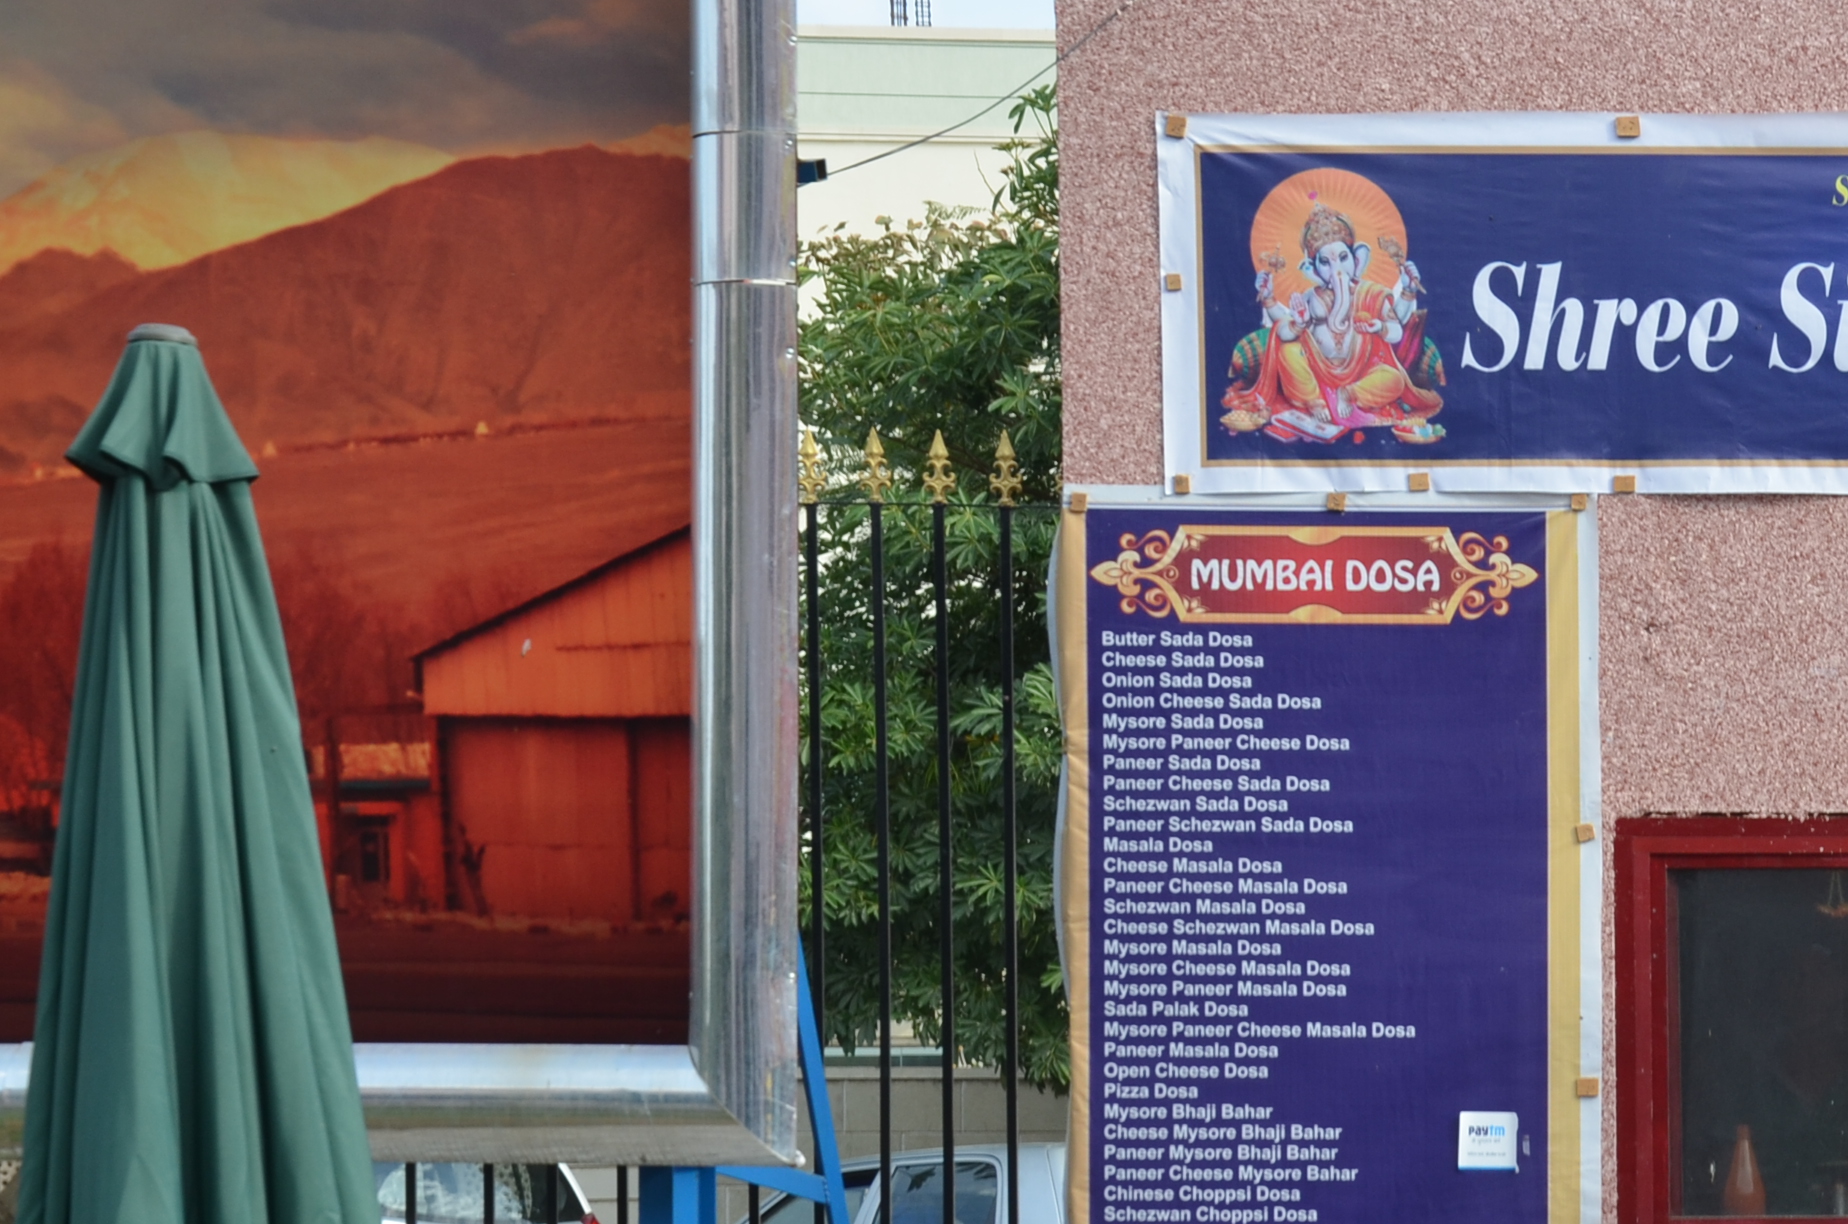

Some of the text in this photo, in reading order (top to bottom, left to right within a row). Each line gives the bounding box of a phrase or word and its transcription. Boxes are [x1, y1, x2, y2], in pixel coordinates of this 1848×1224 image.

[1461, 260, 1739, 373] Shree
[1190, 558, 1440, 592] MUMBAI DOSA
[1101, 631, 1253, 646] Butter Sada Dosa
[1101, 672, 1252, 687] Onion Sada Dosa
[1102, 734, 1350, 752] Mysore Paneer Cheese Dosa
[1103, 775, 1331, 791] Paneer Cheese Sada Dosa
[1103, 796, 1288, 812] Schezwan Sada Dosa
[1103, 837, 1213, 852] Masala Dosa
[1103, 878, 1348, 894] Paneer Cheese Masala Dosa
[1103, 939, 1282, 958] Mysore Masala Dosa
[1104, 1001, 1249, 1016] Sada Palak Dosa
[1103, 1062, 1269, 1080] Open Cheese Dosa
[1103, 1083, 1199, 1098] Pizza Dosa
[1104, 1103, 1274, 1122] Mysore Bhaji Bahar
[1103, 1186, 1175, 1201] Chinese
[1256, 1185, 1301, 1201] Dosa
